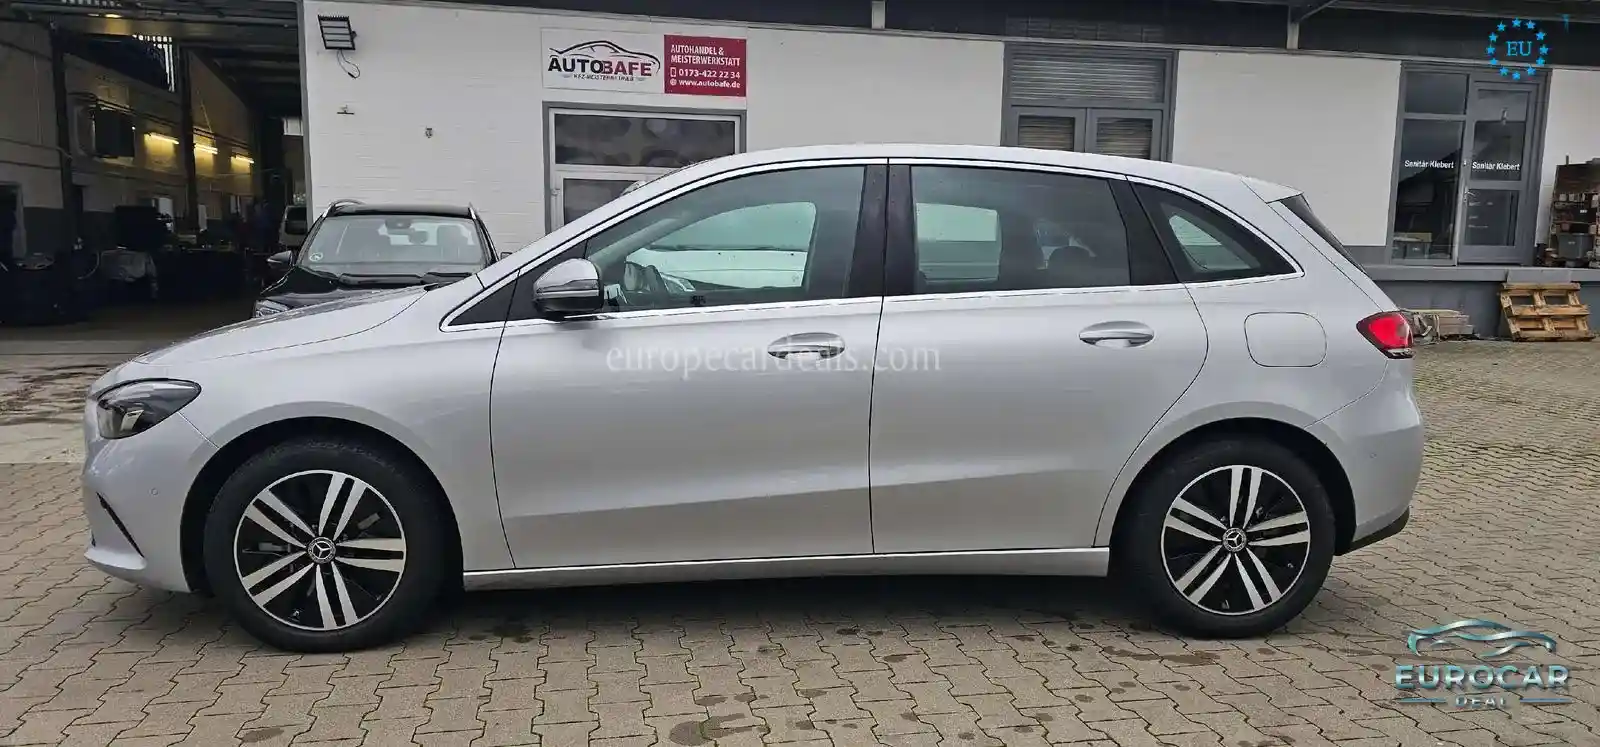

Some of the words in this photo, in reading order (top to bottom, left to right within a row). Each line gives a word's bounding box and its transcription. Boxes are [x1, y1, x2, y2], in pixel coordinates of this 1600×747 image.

[671, 44, 717, 55] AUTOHANDEL
[719, 47, 724, 55] &
[671, 55, 740, 66] MEISTERWERKSTATT
[548, 58, 652, 77] AUTOBAFE
[679, 69, 717, 78] 0173-422
[719, 71, 729, 79] 22
[731, 71, 740, 79] 34
[679, 80, 740, 88] www.autobafe.de
